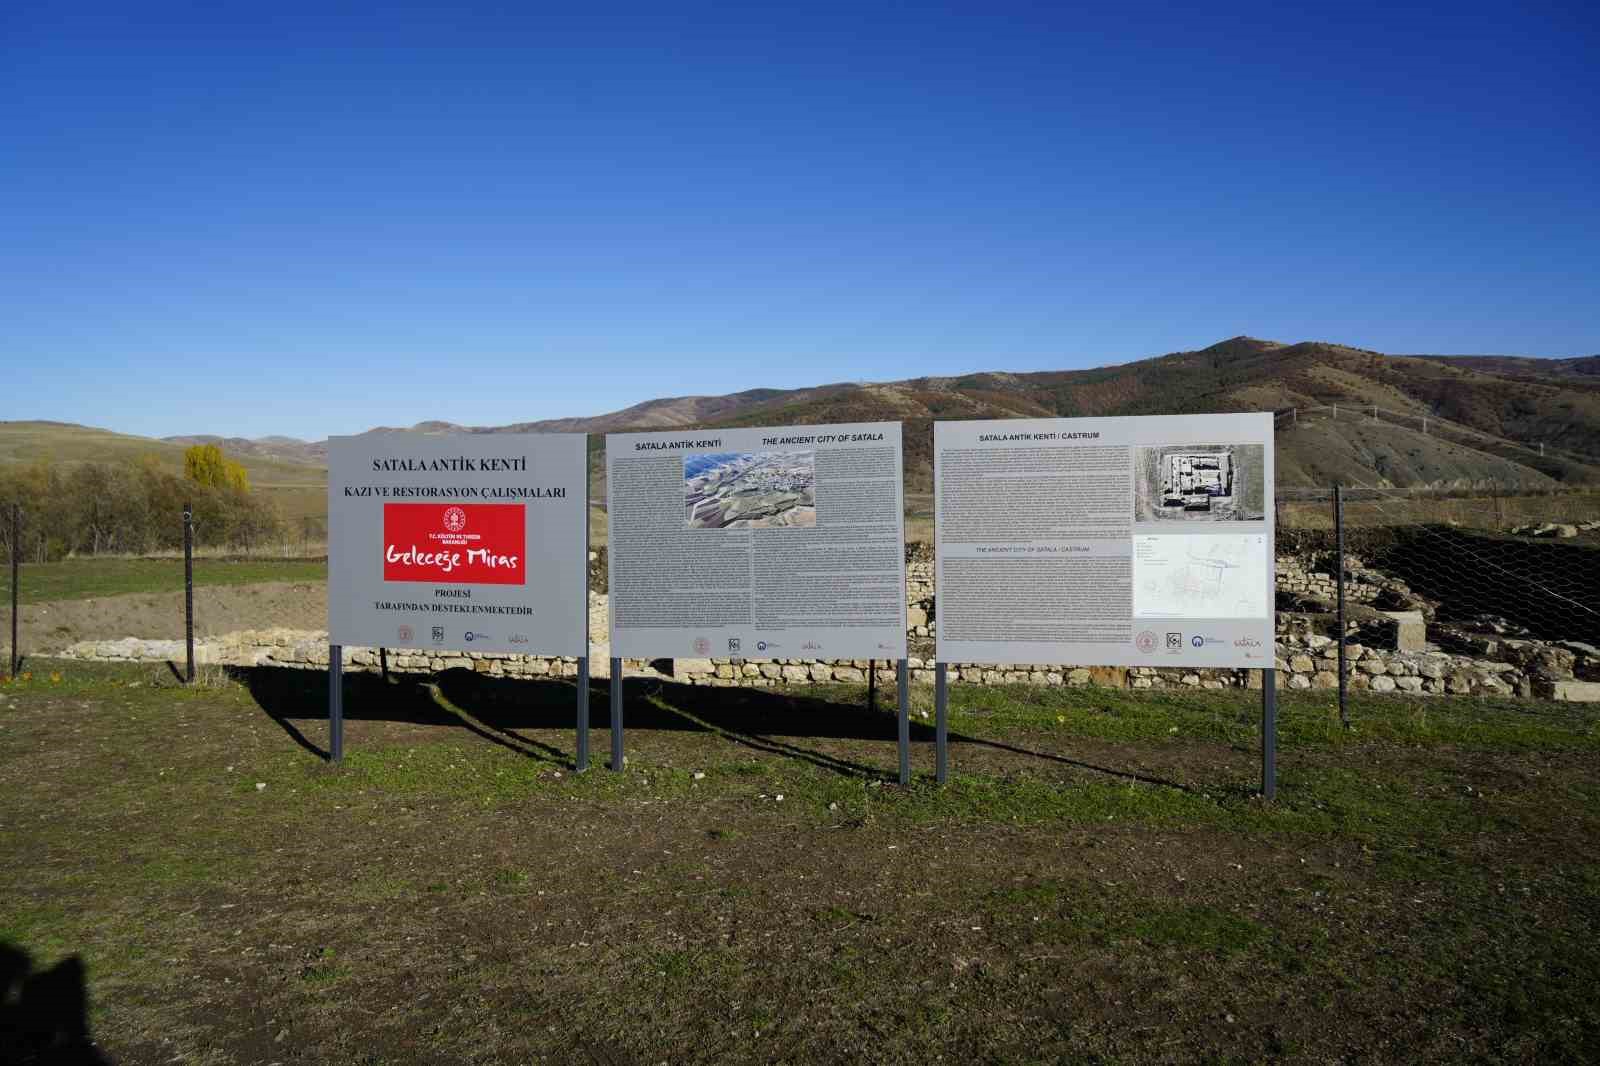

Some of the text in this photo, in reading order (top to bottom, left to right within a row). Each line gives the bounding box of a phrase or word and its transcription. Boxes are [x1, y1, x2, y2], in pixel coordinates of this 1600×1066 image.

[761, 433, 884, 446] THE ANCIENT CITY OF SATALA
[979, 433, 1007, 442] SATALA
[1033, 431, 1056, 441] KENTİ
[1061, 431, 1100, 440] CASTRUM
[635, 438, 722, 451] SATALA ANTİK KENTİ
[372, 455, 526, 472] SATALA ANTİK KENTİ
[344, 486, 566, 500] KAZI VE RESTORASYON ÇALIŞMALARI
[386, 544, 519, 572] Geleceğe Miras
[434, 588, 472, 599] PROJESİ
[375, 601, 533, 616] TARAFINDAN DESTEKLENMEKTEDİR
